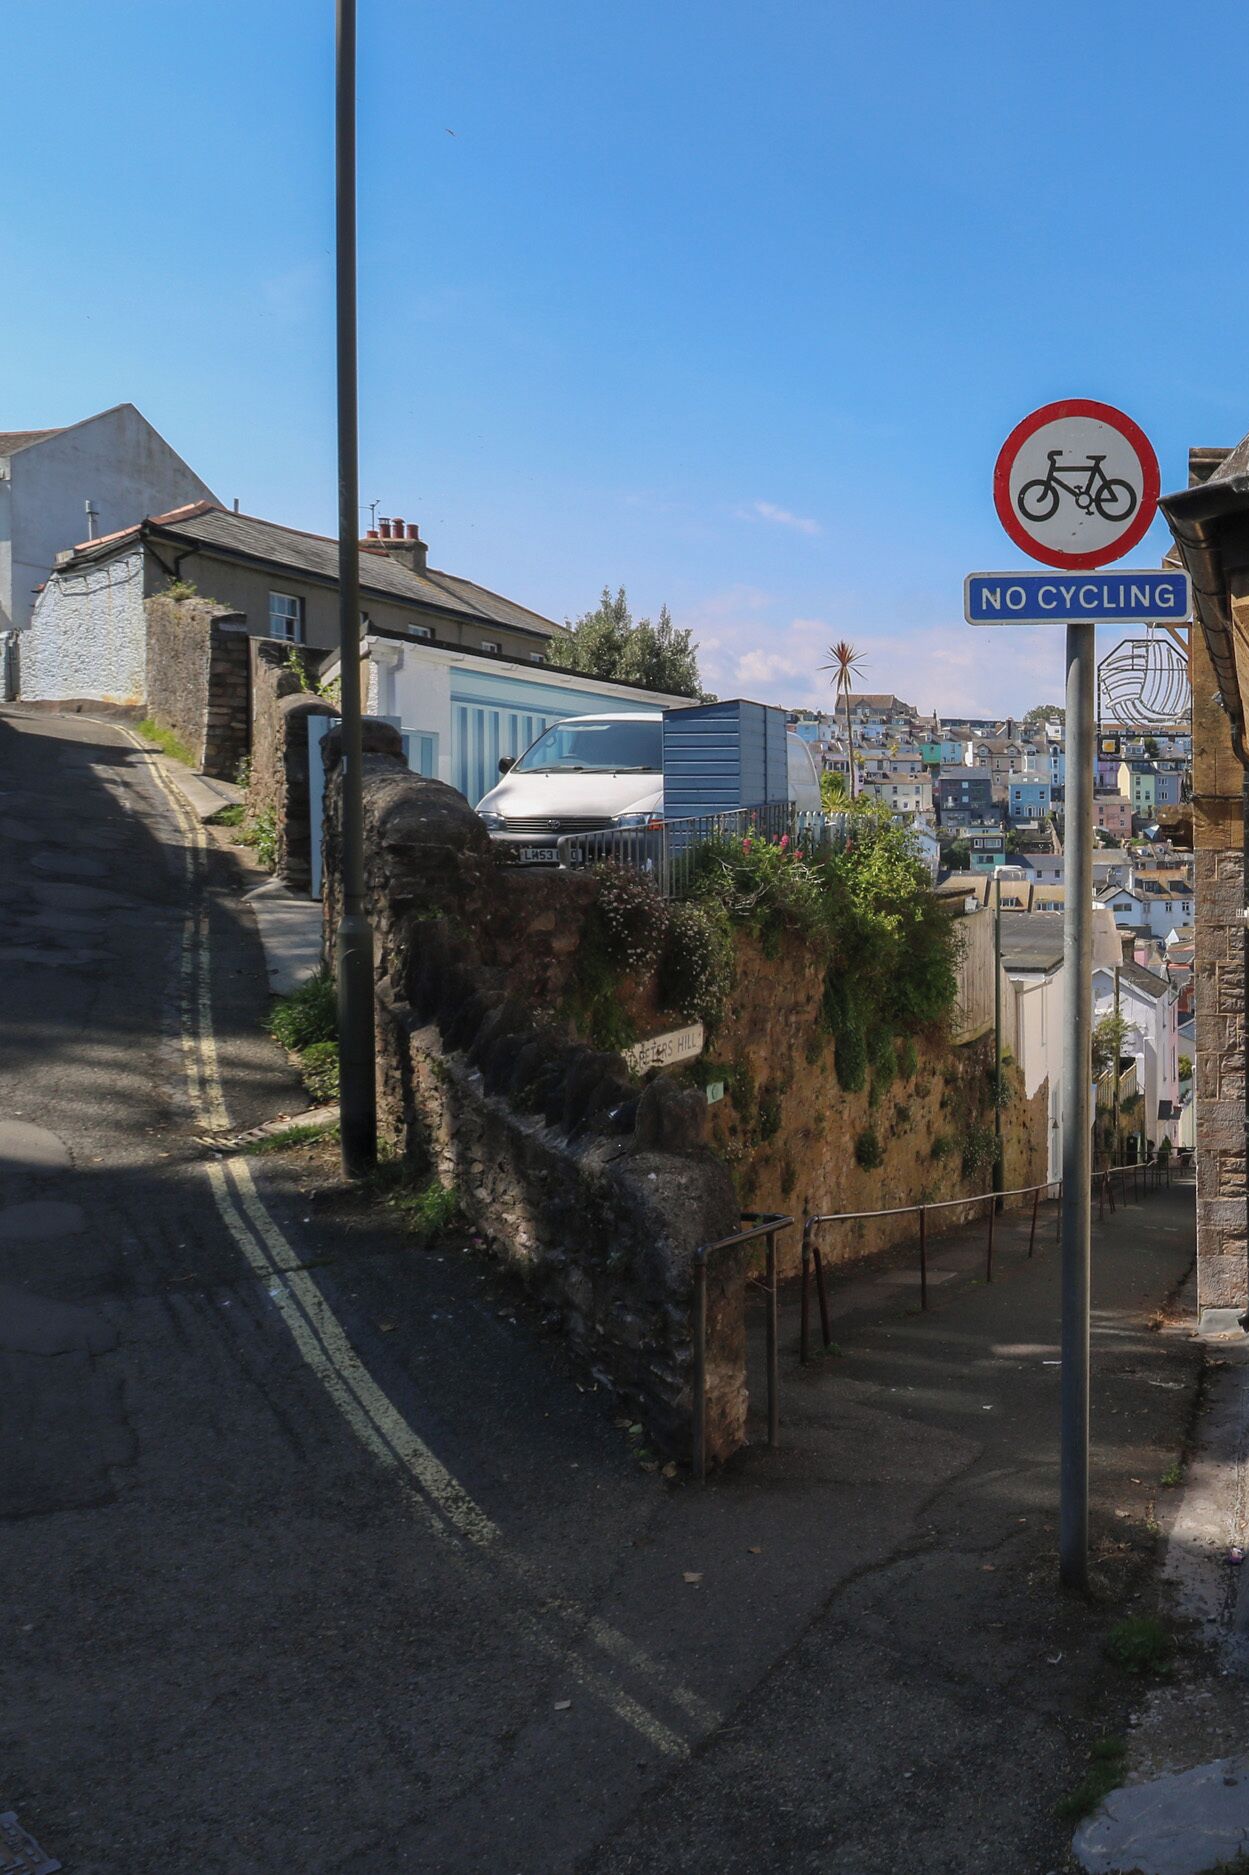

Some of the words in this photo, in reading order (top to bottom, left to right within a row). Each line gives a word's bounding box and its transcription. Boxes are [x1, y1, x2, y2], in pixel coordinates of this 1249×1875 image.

[981, 586, 1027, 610] NO
[1037, 583, 1175, 609] CYCLING
[677, 1033, 697, 1053] HILL
